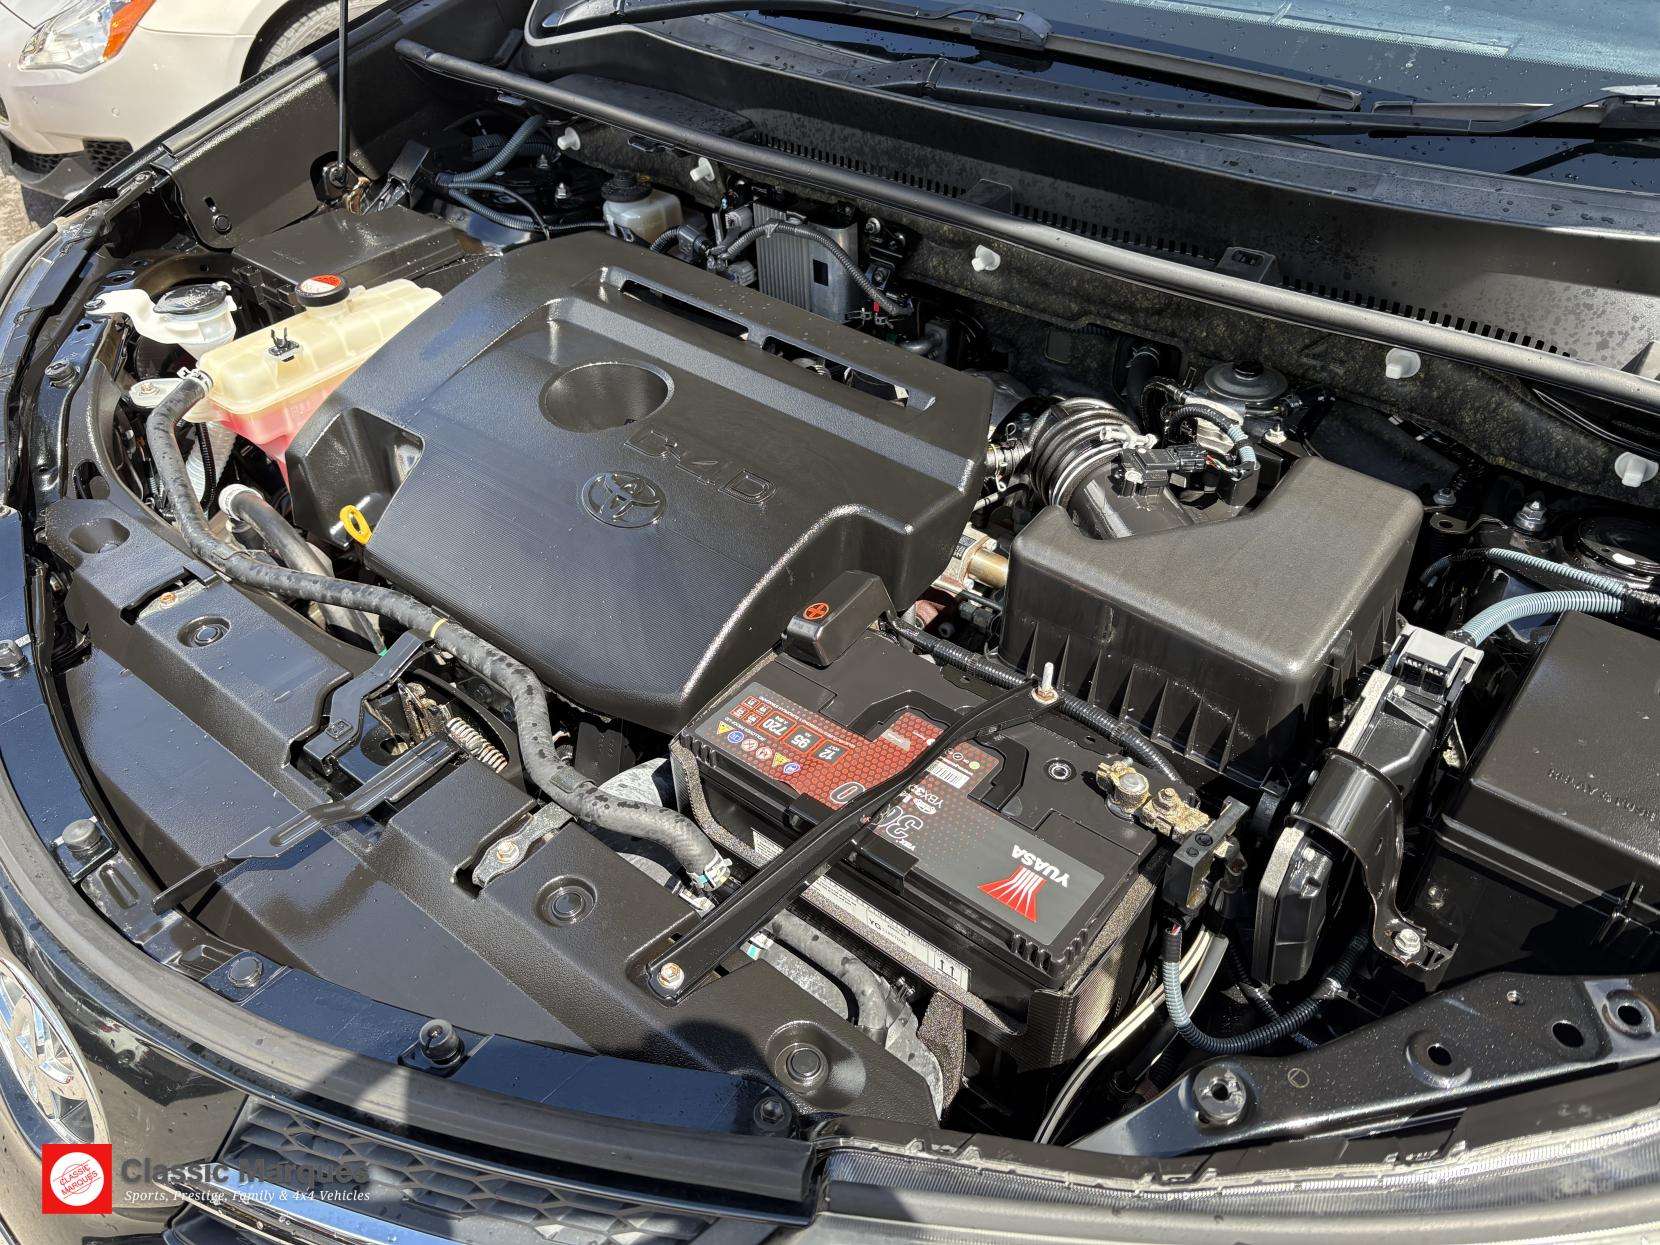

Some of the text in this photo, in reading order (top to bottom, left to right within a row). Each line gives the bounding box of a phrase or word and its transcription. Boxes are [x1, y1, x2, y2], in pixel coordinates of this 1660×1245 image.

[762, 719, 787, 736] 720
[791, 734, 811, 748] 95
[819, 748, 836, 760] 12
[1012, 844, 1070, 888] YUASA
